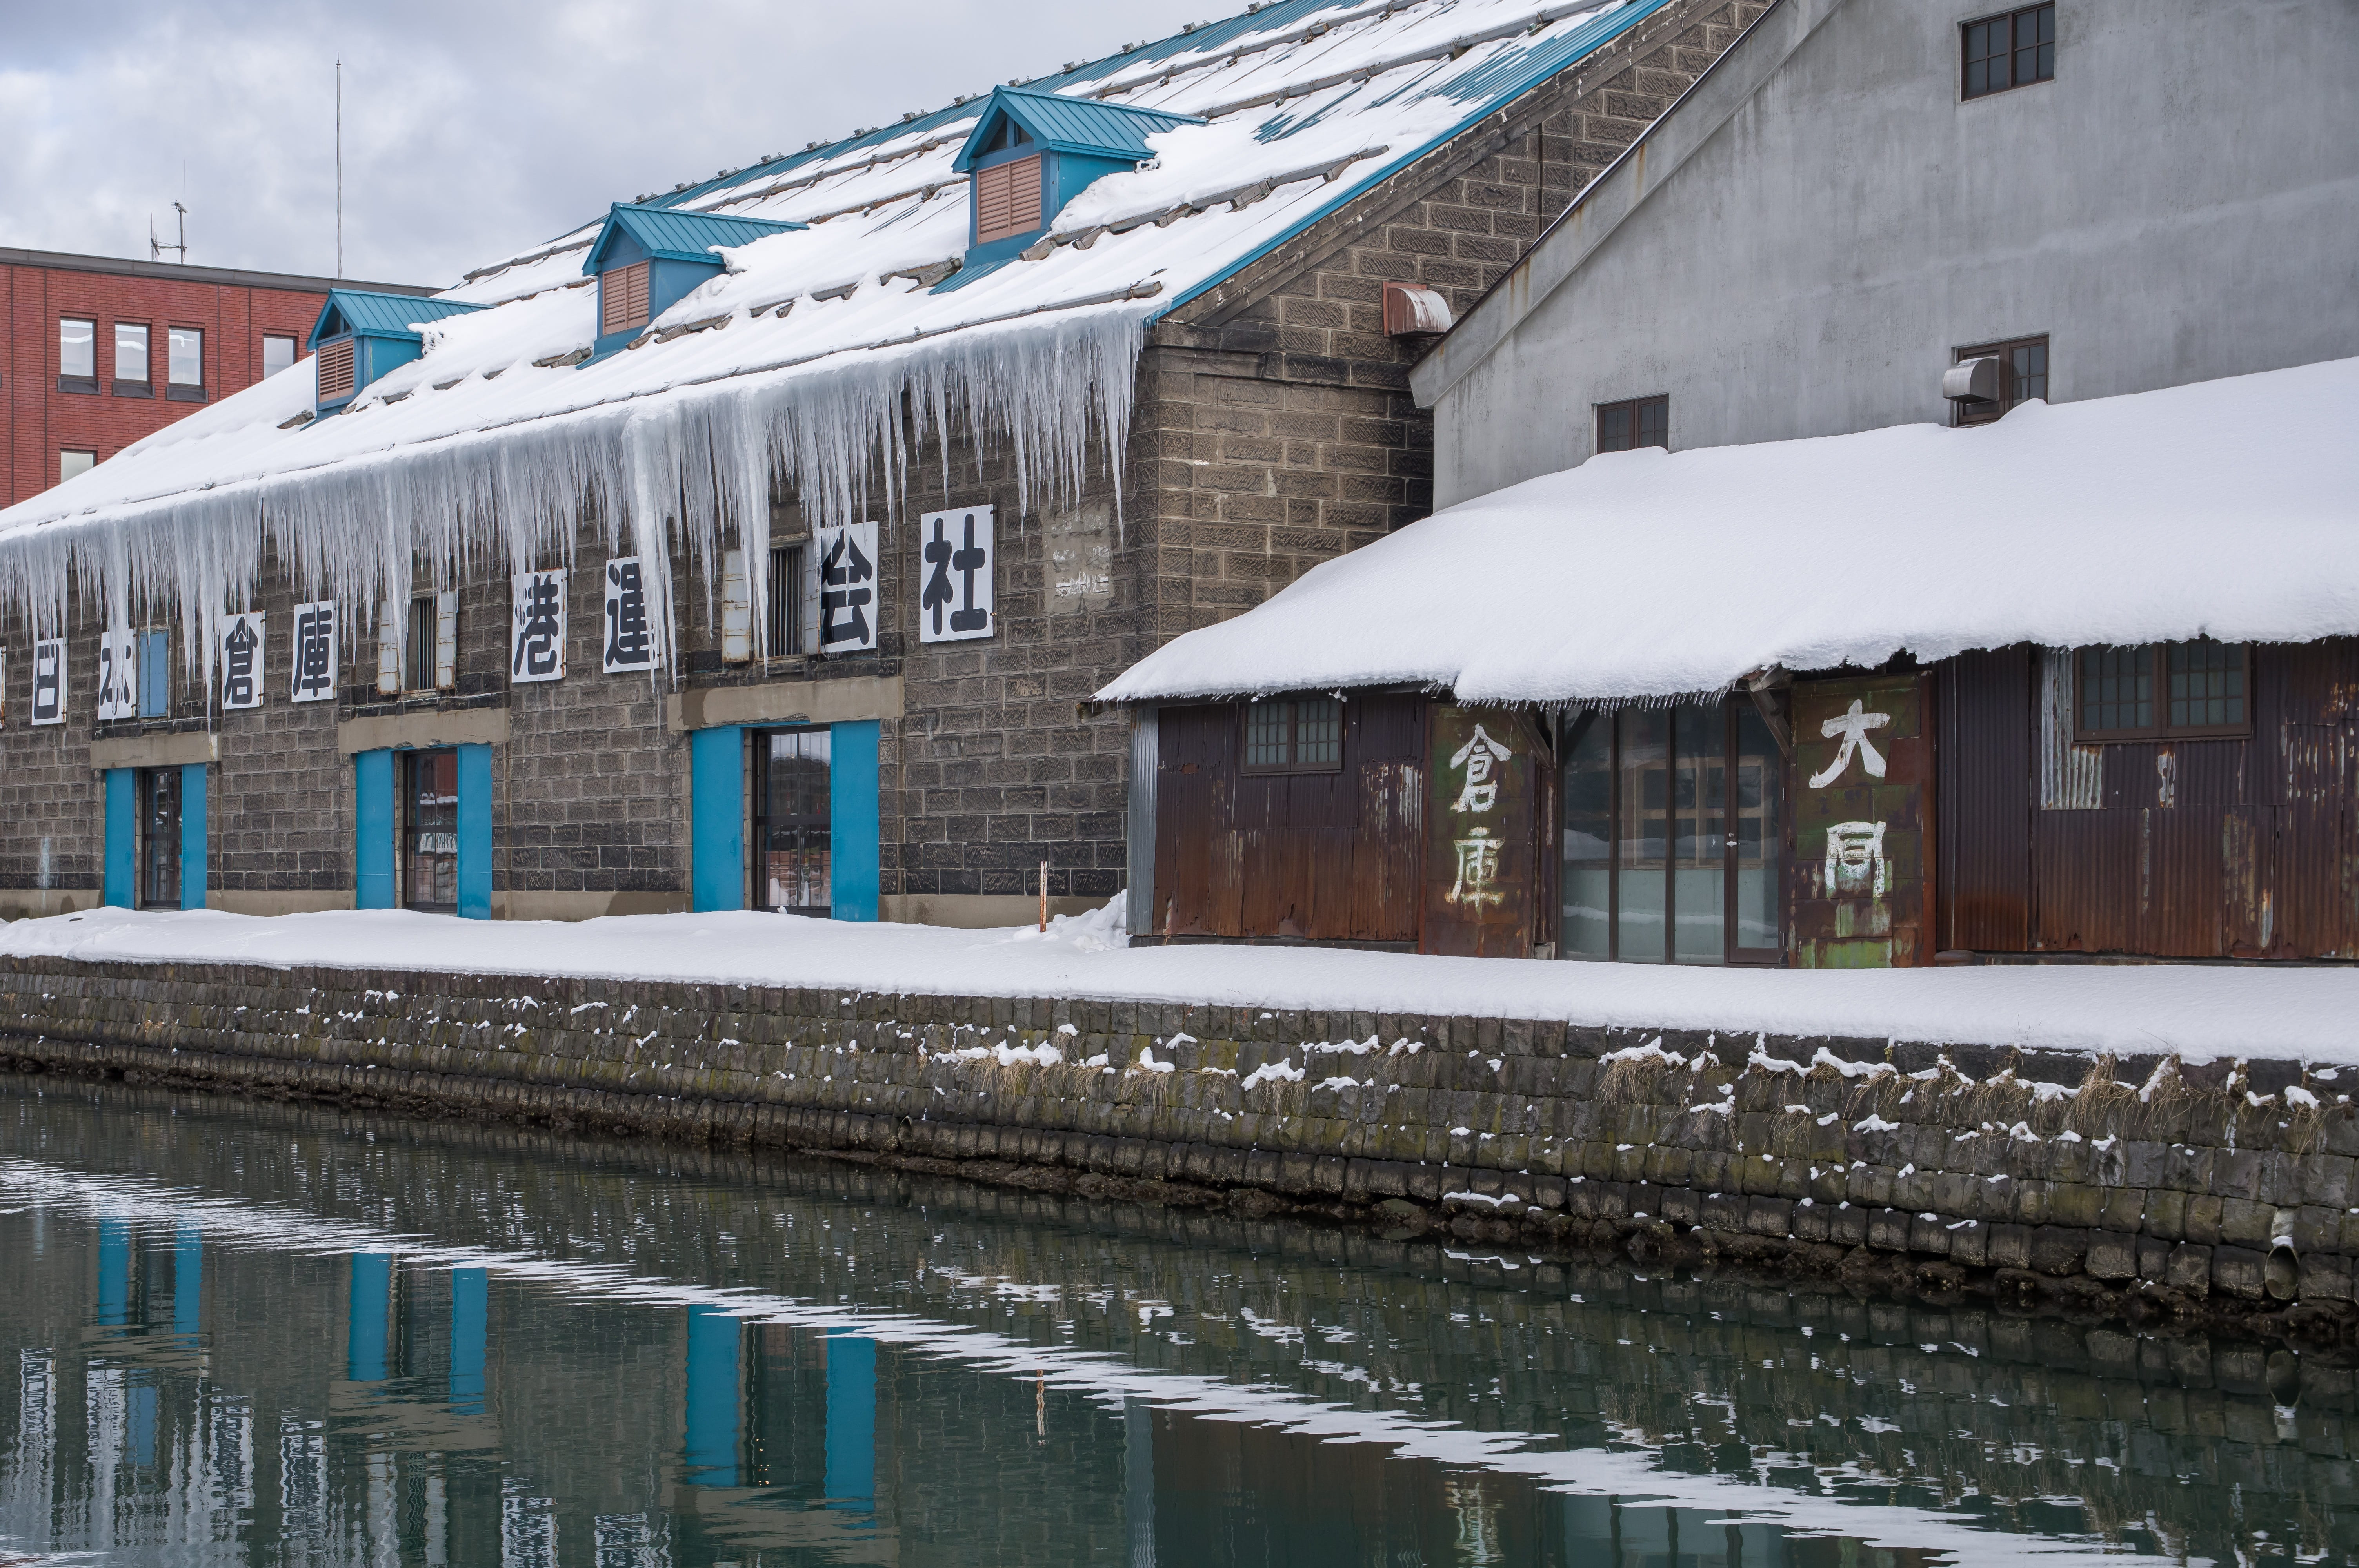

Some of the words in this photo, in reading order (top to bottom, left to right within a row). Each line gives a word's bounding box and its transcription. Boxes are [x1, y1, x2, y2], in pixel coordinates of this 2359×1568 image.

[34, 644, 59, 720] 日
[225, 616, 258, 705] 倉
[293, 604, 333, 698] 庫
[513, 574, 559, 676] 港
[605, 563, 656, 667] 運
[821, 528, 873, 646] 会
[922, 513, 988, 636] 社
[1444, 723, 1512, 919] 倉庫
